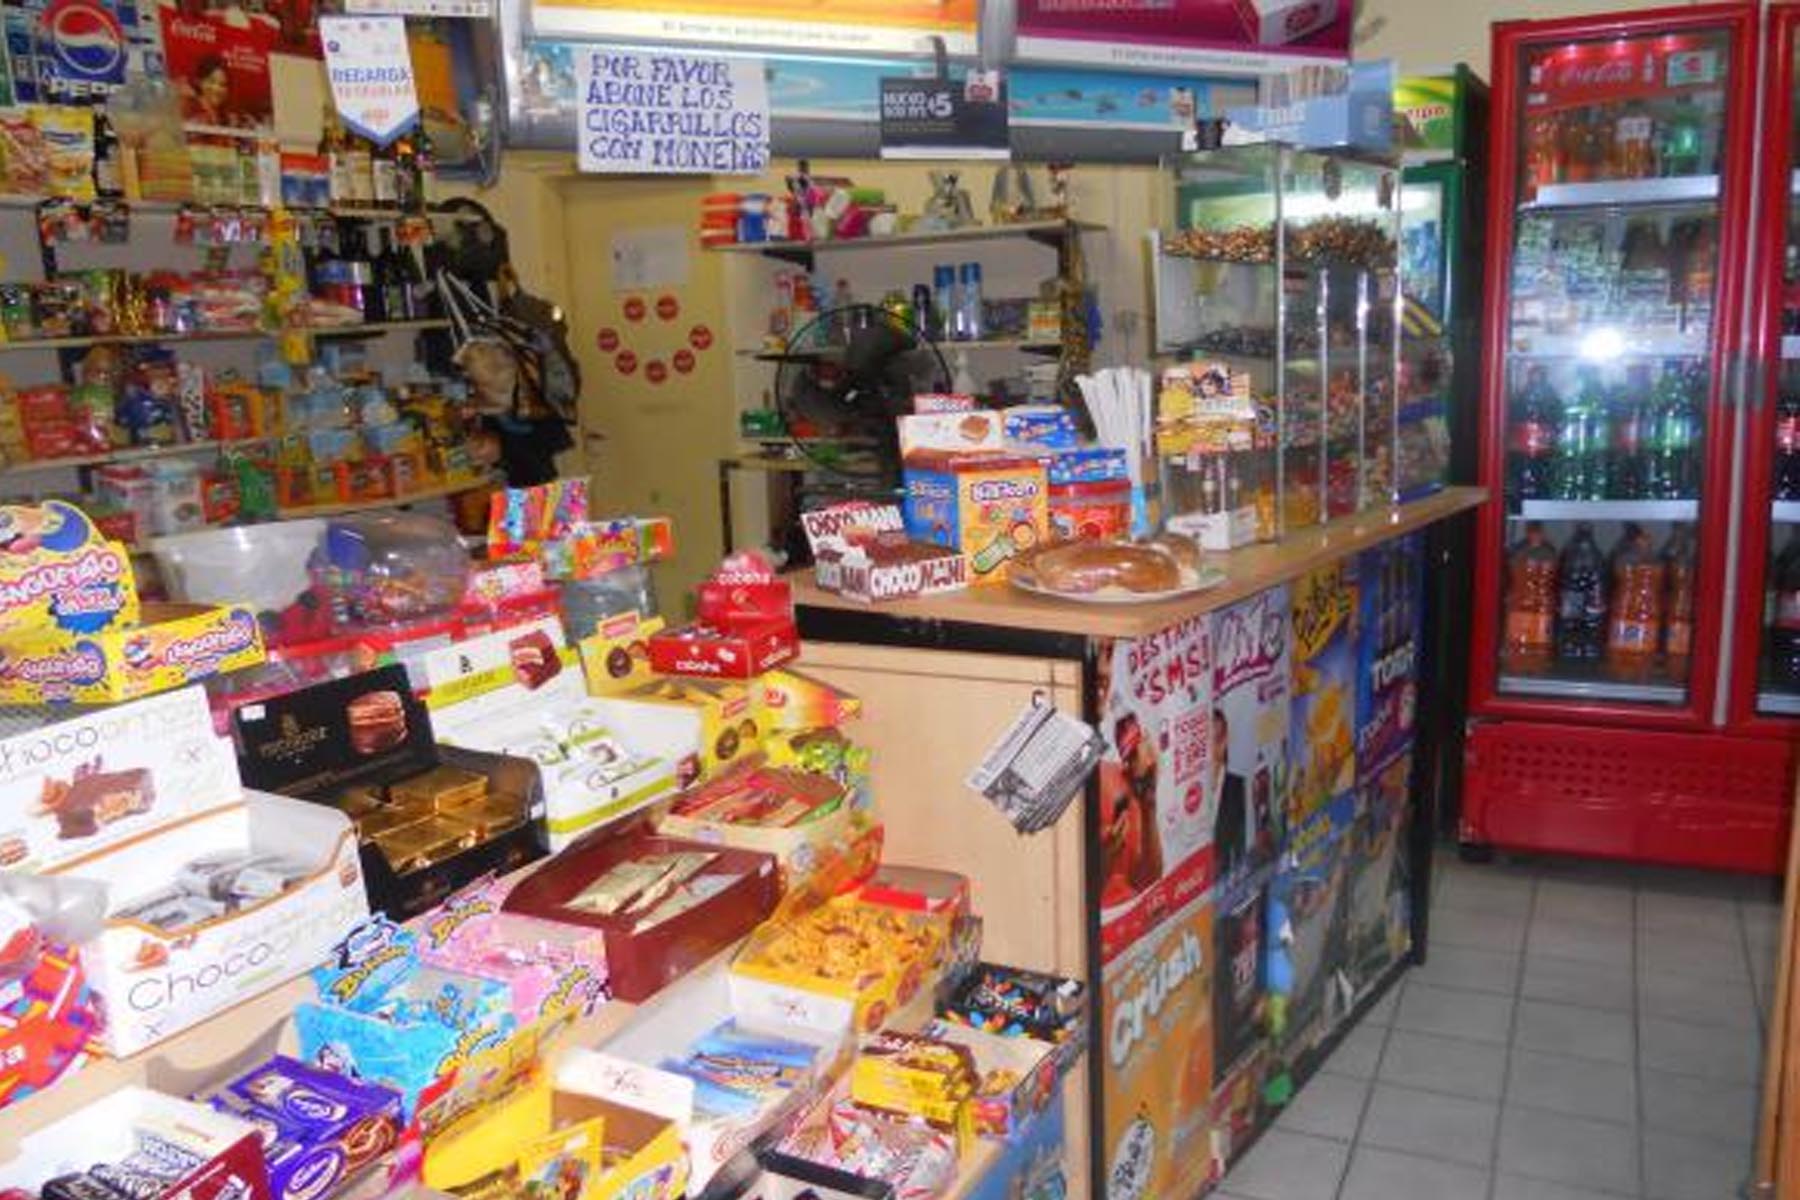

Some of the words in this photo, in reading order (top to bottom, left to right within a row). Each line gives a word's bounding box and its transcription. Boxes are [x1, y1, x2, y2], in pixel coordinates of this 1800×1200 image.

[592, 53, 643, 80] POR
[650, 58, 735, 88] FAVOR
[586, 80, 672, 108] ABONE
[681, 86, 734, 110] LOS
[586, 108, 762, 139] CIGARRILLOS
[588, 136, 643, 160] CON
[651, 138, 768, 170] MONEDAS
